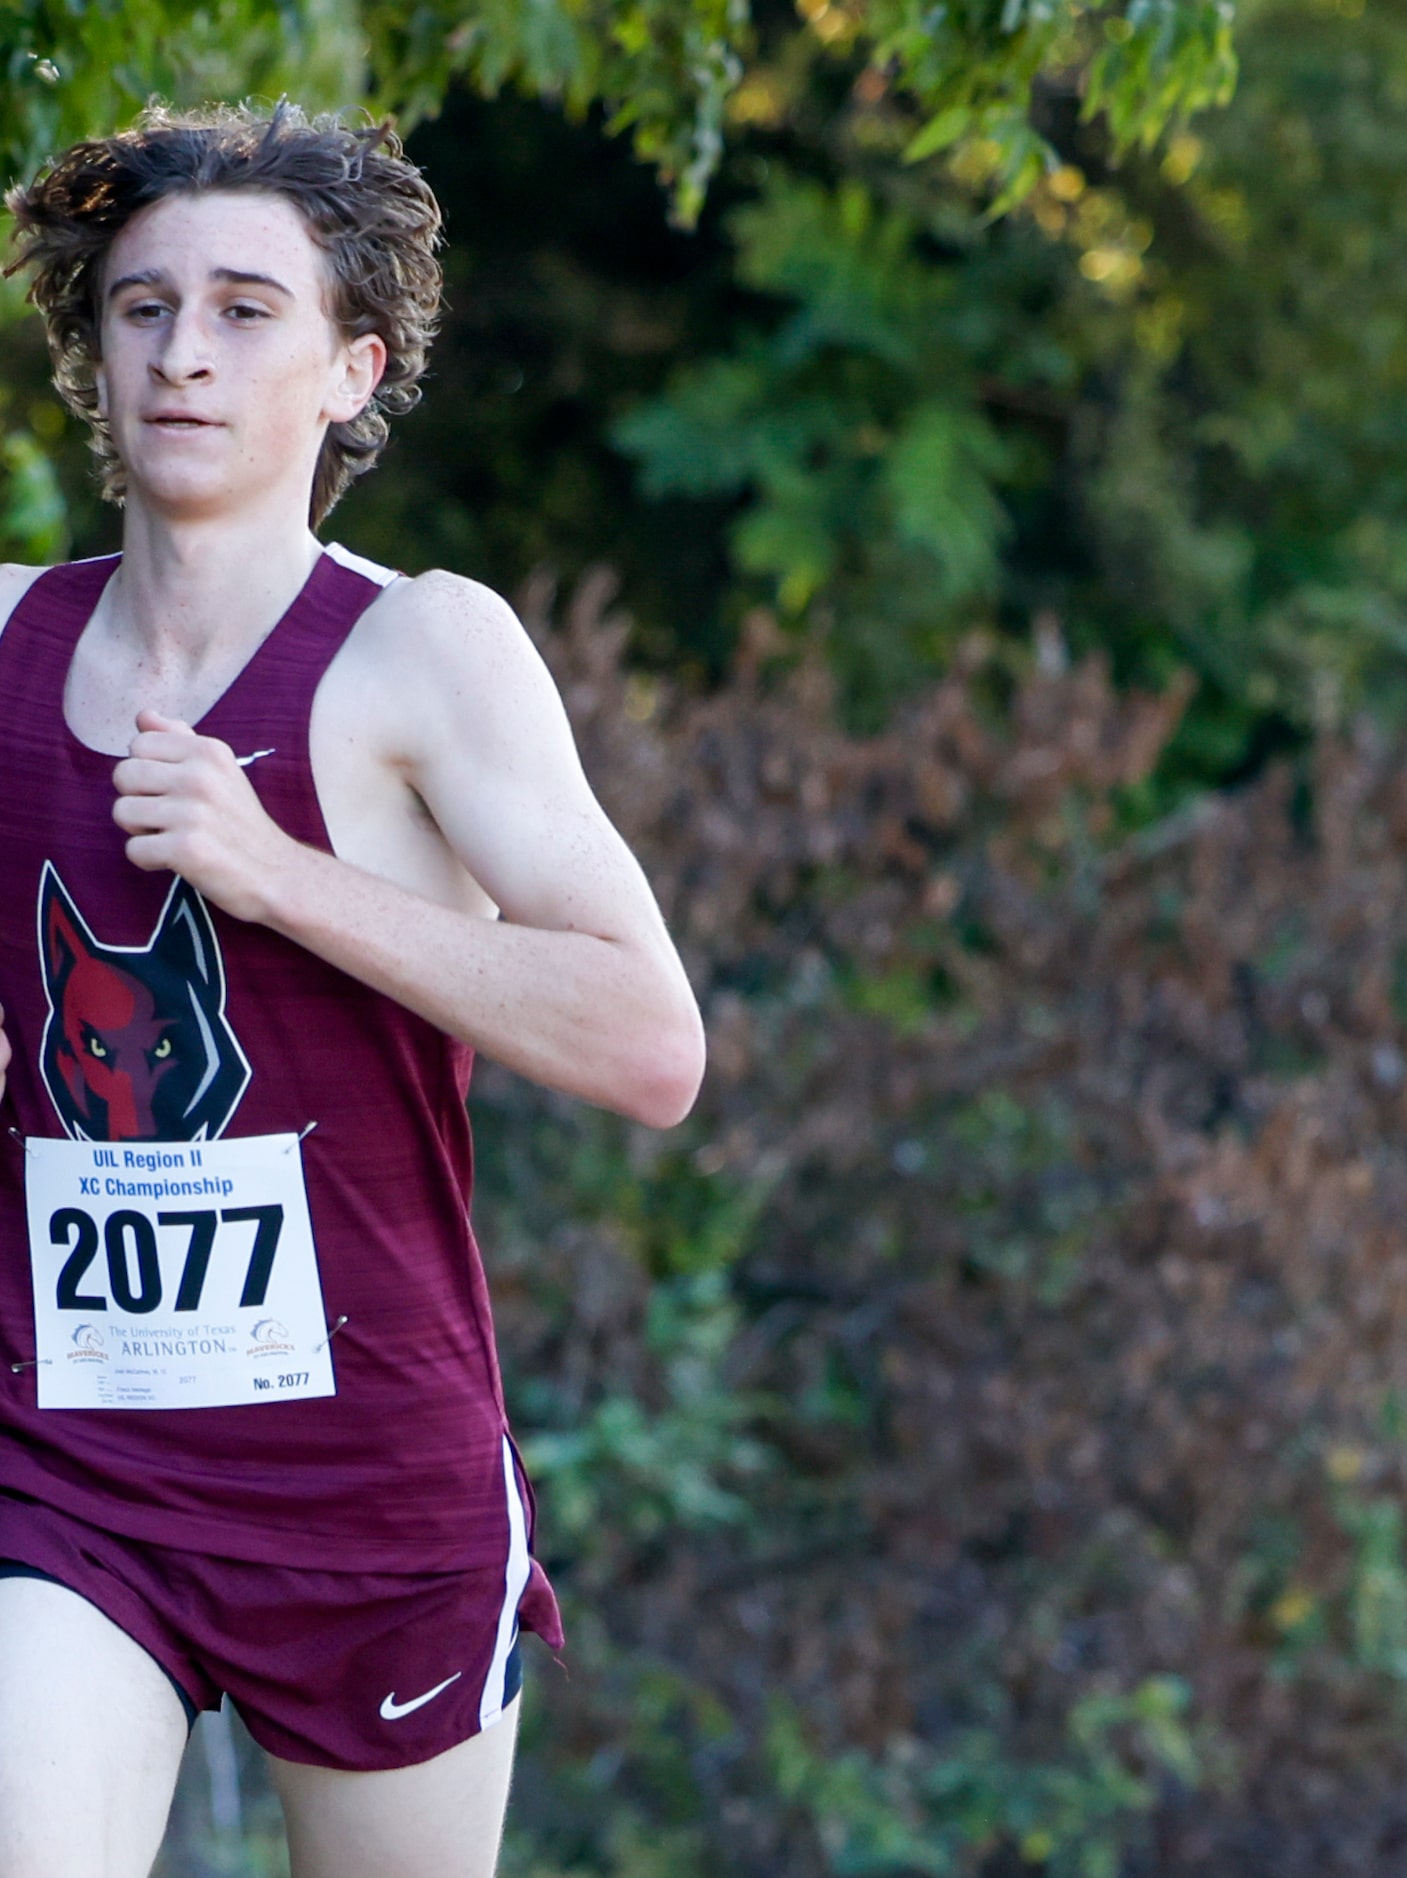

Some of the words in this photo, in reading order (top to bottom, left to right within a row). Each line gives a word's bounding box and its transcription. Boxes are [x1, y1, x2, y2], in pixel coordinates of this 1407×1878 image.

[94, 1149, 119, 1168] UIL
[124, 1149, 184, 1172] Region
[190, 1149, 203, 1167] II
[79, 1177, 101, 1196] XC
[105, 1175, 234, 1200] Championship
[48, 1203, 285, 1315] 2077
[108, 1325, 128, 1338] The
[130, 1325, 184, 1340] University
[187, 1325, 200, 1337] of
[204, 1324, 237, 1336] Texas
[66, 1349, 110, 1361] MAVERICKS
[121, 1338, 227, 1357] ARLINGTON
[245, 1343, 296, 1356] MAVERICKS
[252, 1377, 275, 1391] No.
[277, 1371, 311, 1388] 2077
